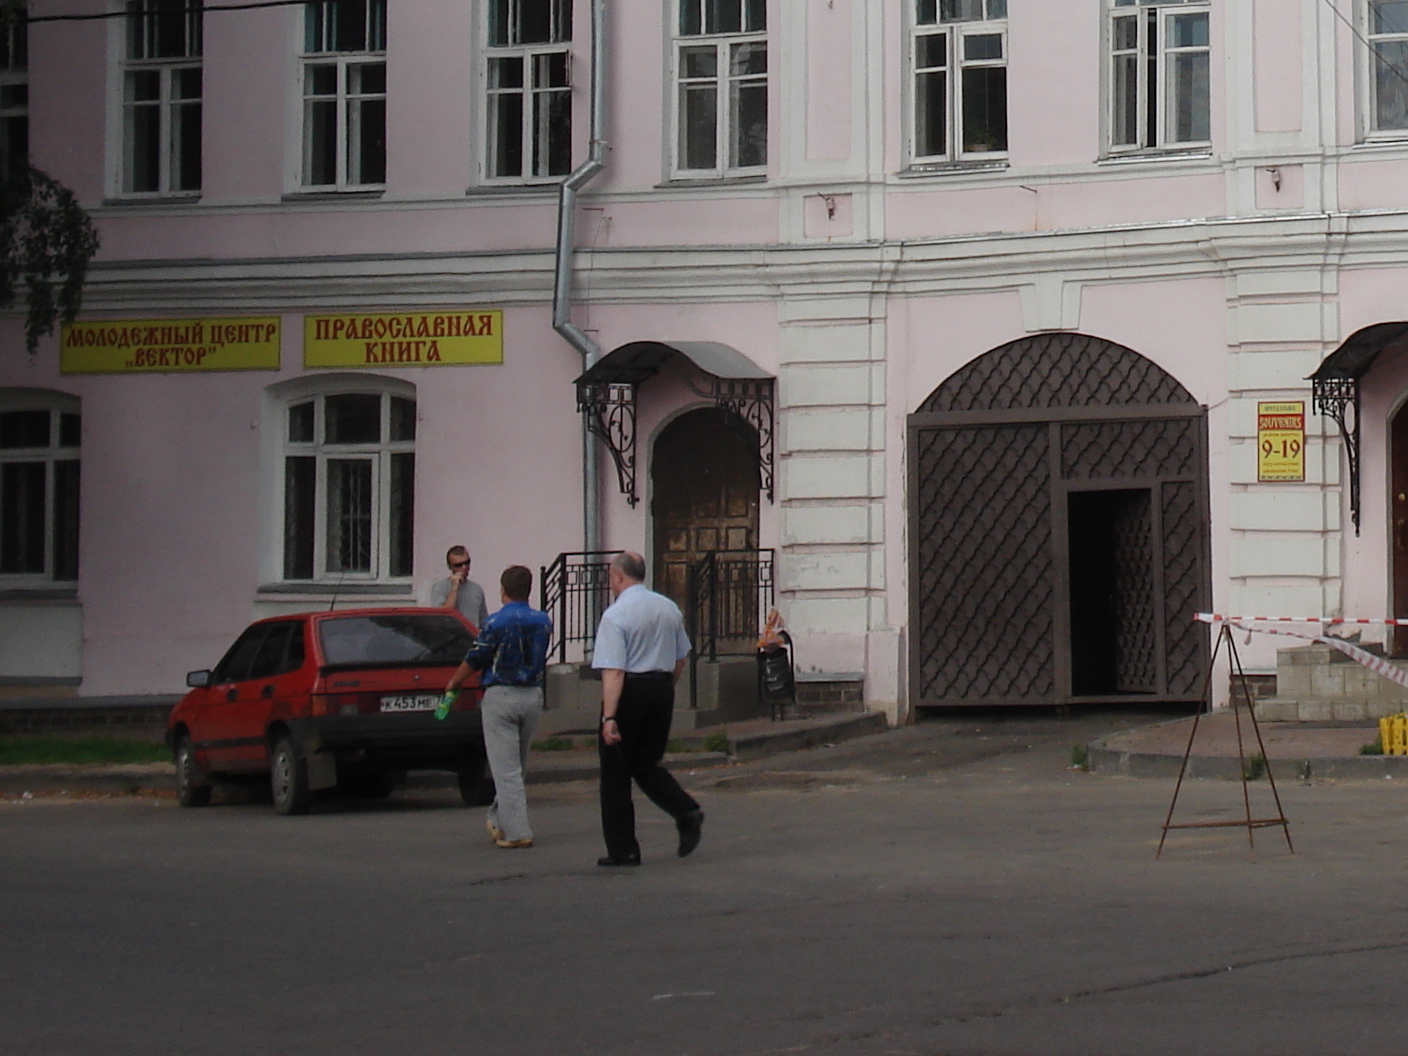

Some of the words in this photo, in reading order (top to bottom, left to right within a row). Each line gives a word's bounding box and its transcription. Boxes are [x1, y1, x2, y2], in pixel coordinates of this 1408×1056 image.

[66, 322, 204, 349] МОЛОДЕЖНЫЙ
[210, 323, 276, 348] ЦЕНТР
[315, 315, 493, 340] ПРАВОСЛАВНАЯ
[364, 340, 441, 363] КНИГА
[1262, 439, 1301, 459] 9-19
